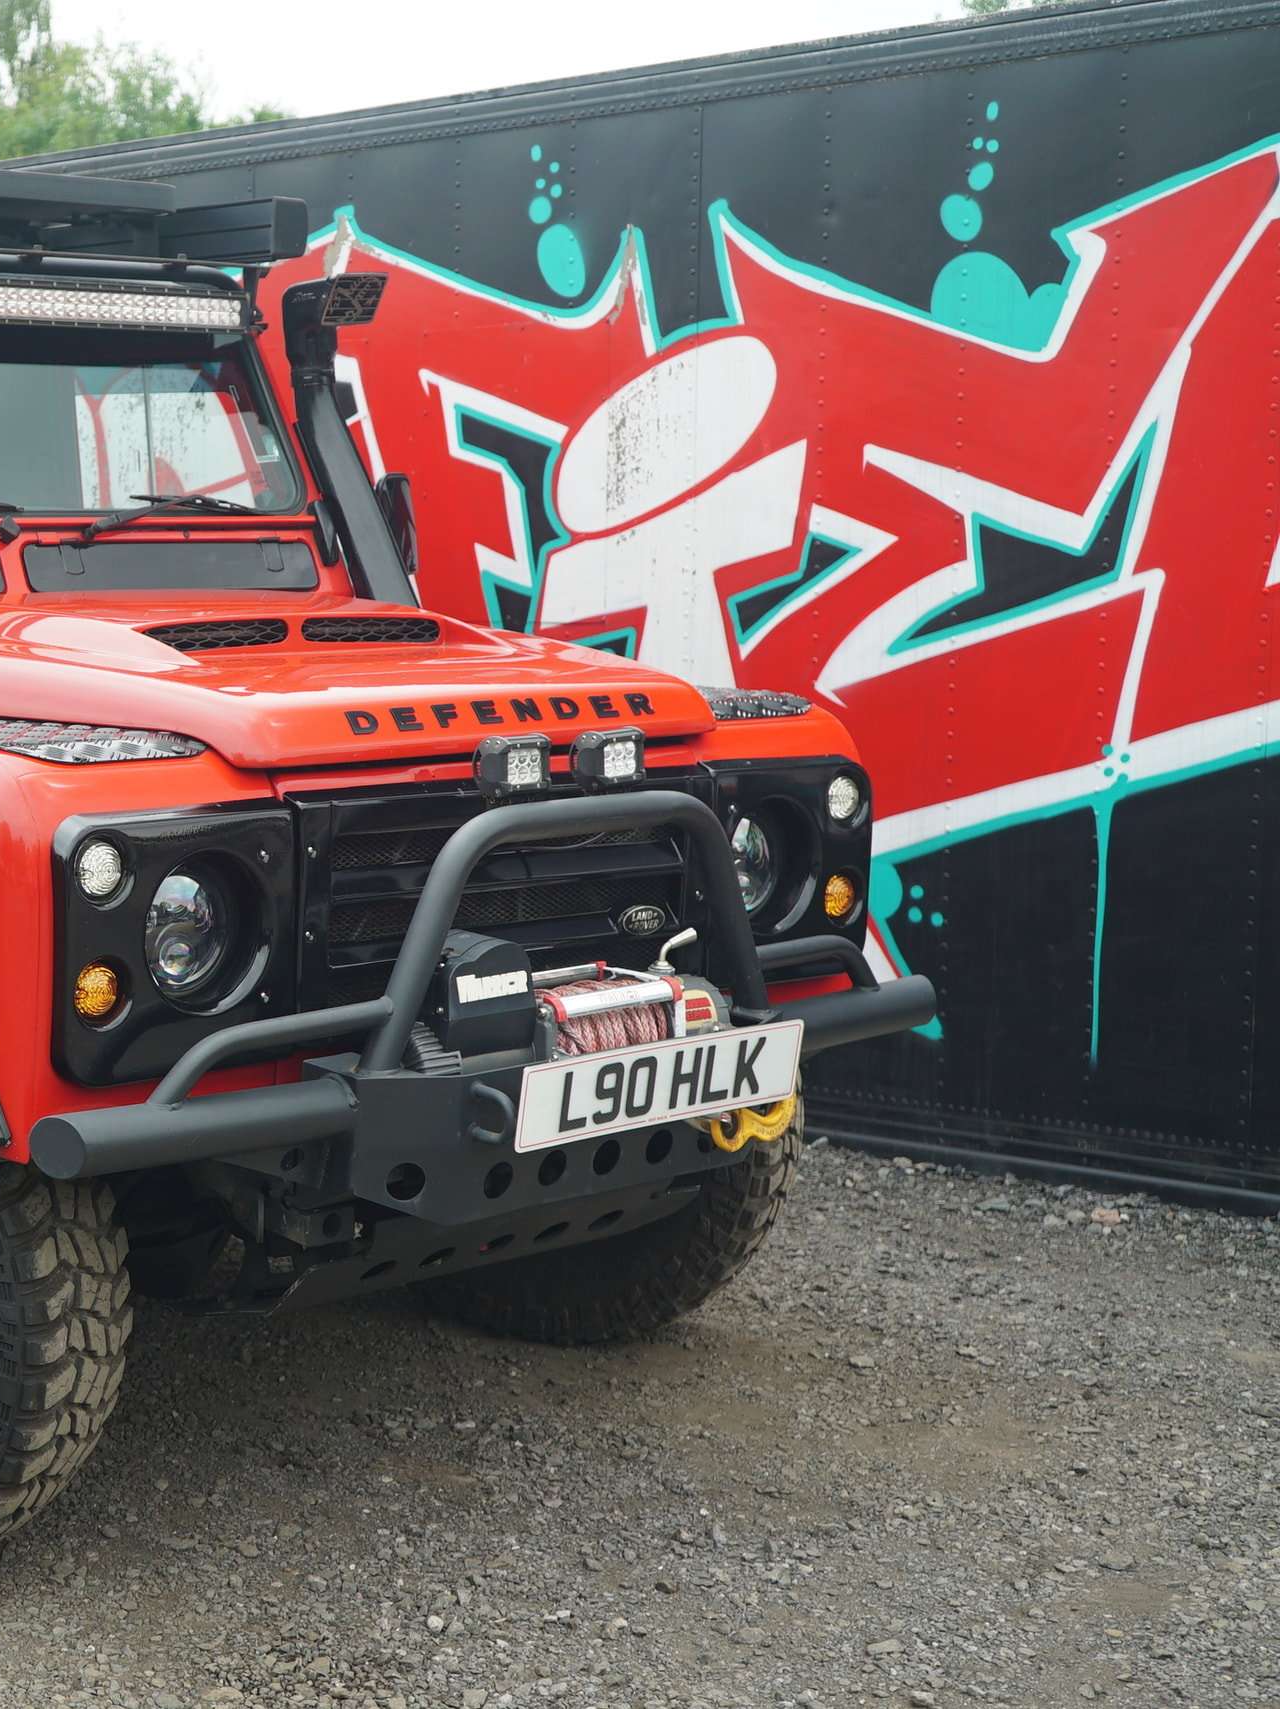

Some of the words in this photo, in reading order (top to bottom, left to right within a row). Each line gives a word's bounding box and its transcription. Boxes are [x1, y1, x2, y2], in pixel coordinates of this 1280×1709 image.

[343, 692, 656, 736] DEFENDER
[631, 910, 653, 922] LAND
[558, 1055, 658, 1134] L90
[669, 1036, 767, 1110] HLK
